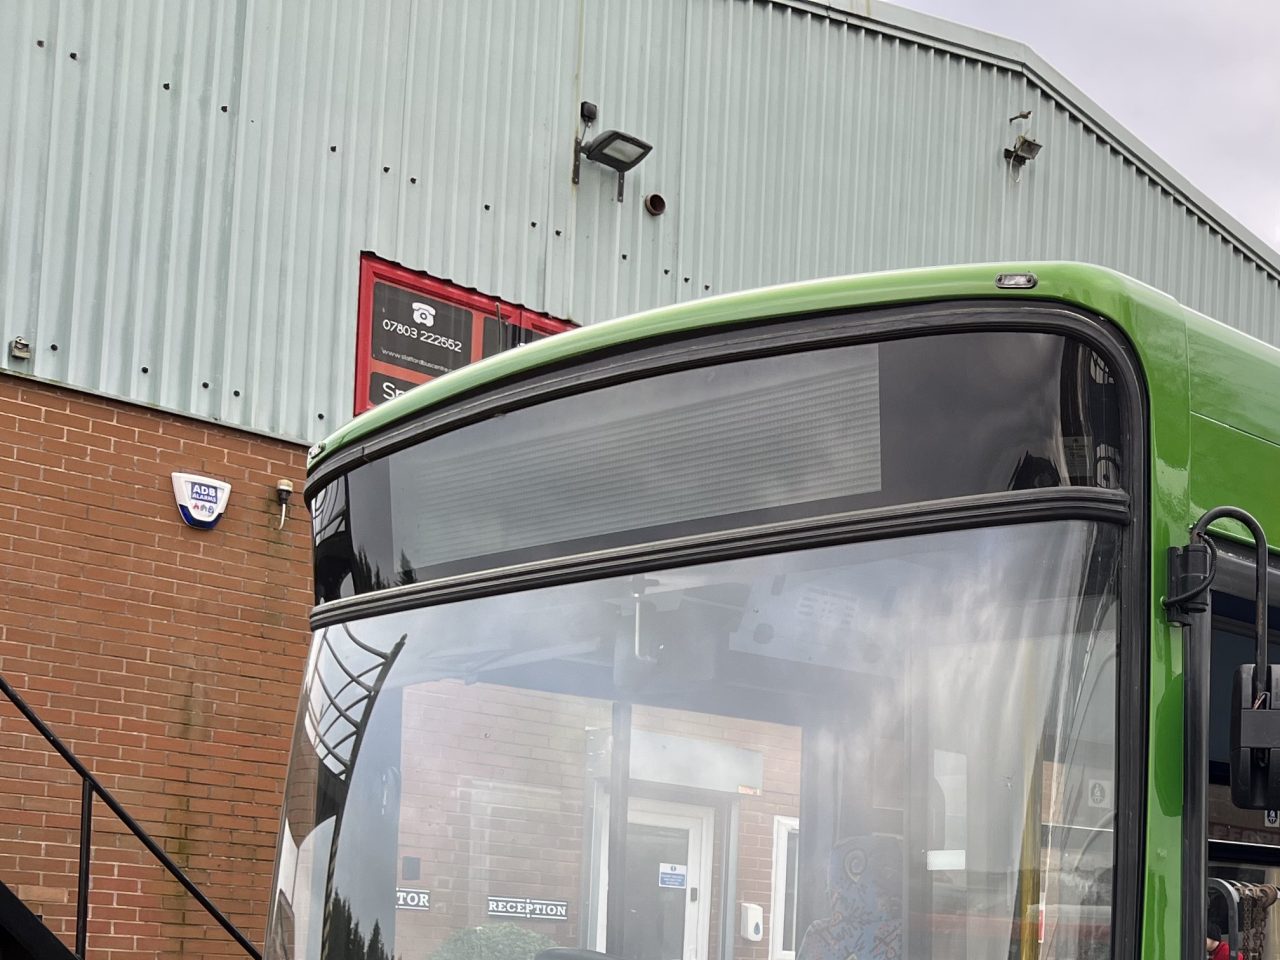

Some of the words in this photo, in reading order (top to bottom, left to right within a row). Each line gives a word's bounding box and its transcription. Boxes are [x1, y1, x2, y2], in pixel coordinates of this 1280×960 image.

[382, 319, 418, 339] 07803
[420, 330, 463, 353] 222552
[192, 484, 216, 497] ADB
[397, 892, 429, 907] TOR
[488, 901, 567, 916] RECEPTION
